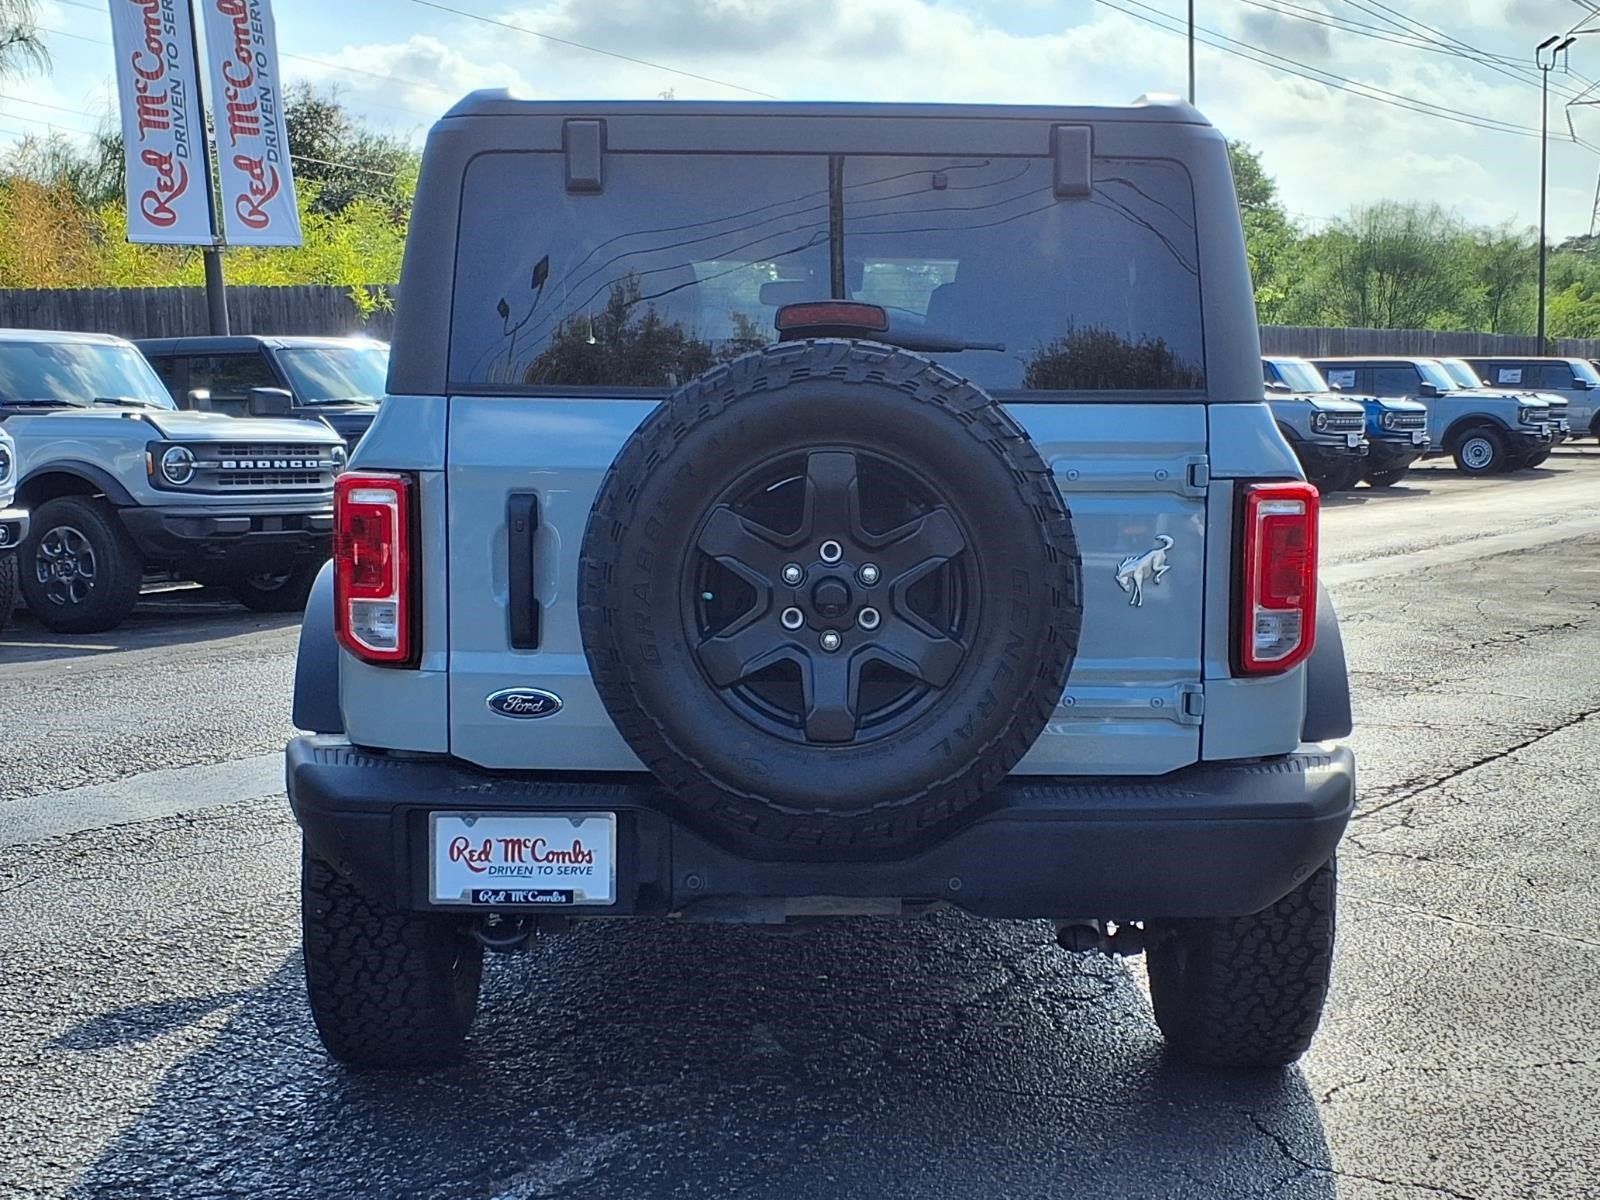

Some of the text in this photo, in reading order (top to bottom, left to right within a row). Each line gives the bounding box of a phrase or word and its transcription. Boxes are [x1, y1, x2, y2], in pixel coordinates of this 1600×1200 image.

[166, 43, 179, 71] TO
[255, 51, 268, 79] TO
[128, 0, 188, 226] Red McCom
[169, 80, 188, 159] DRIVEN
[259, 87, 278, 163] DRIVEN
[236, 155, 280, 229] Red
[929, 566, 1031, 758] GENERAL
[503, 694, 544, 711] Ford
[449, 836, 593, 873] Red McCombs
[488, 866, 593, 875] DRIVEN TO SERVE
[479, 889, 566, 904] Red McCombs
